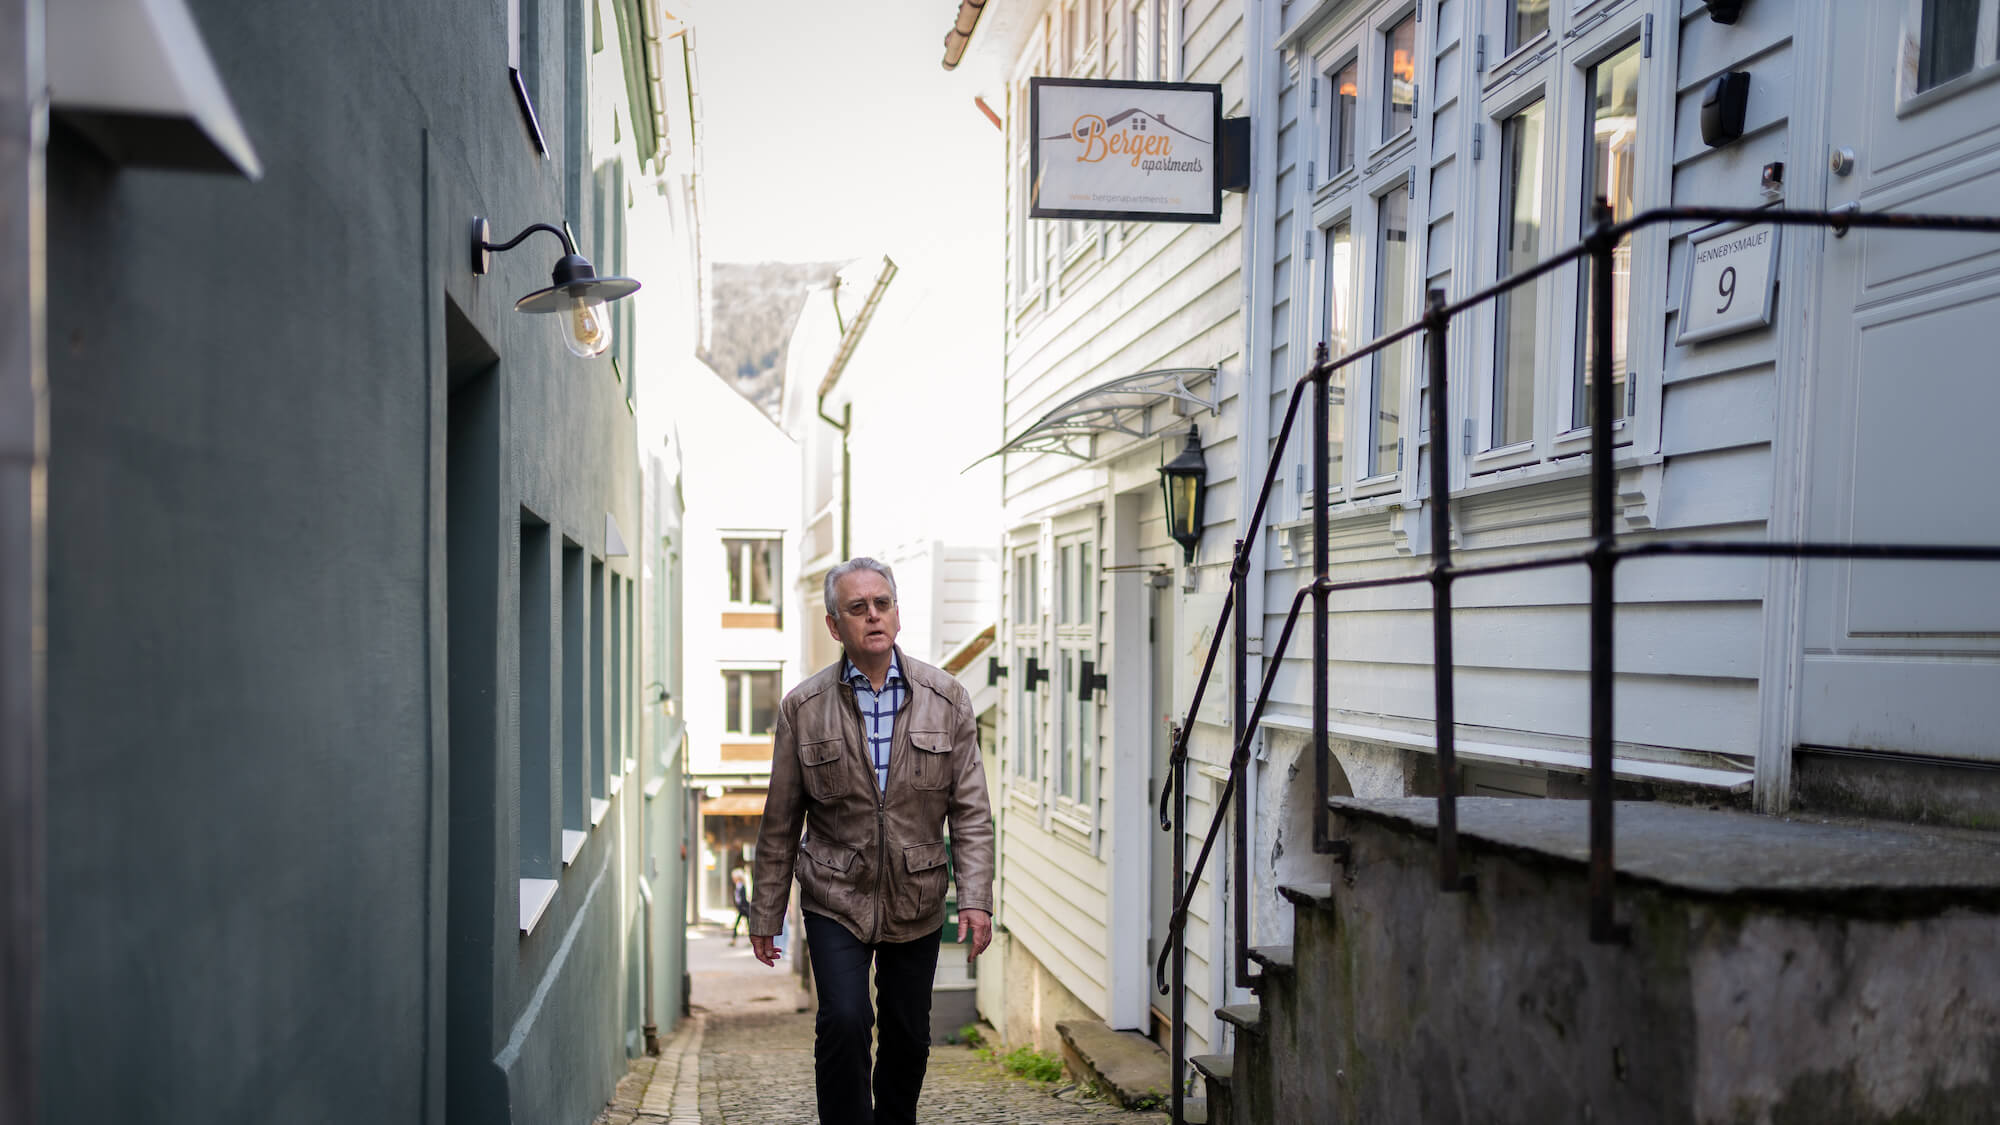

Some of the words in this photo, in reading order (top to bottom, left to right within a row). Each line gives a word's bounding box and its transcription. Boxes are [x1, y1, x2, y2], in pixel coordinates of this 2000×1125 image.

[1072, 114, 1172, 167] Bergen
[1142, 157, 1202, 176] apartments
[1696, 231, 1768, 264] HENNEBYSMAUET
[1716, 266, 1736, 314] 9
